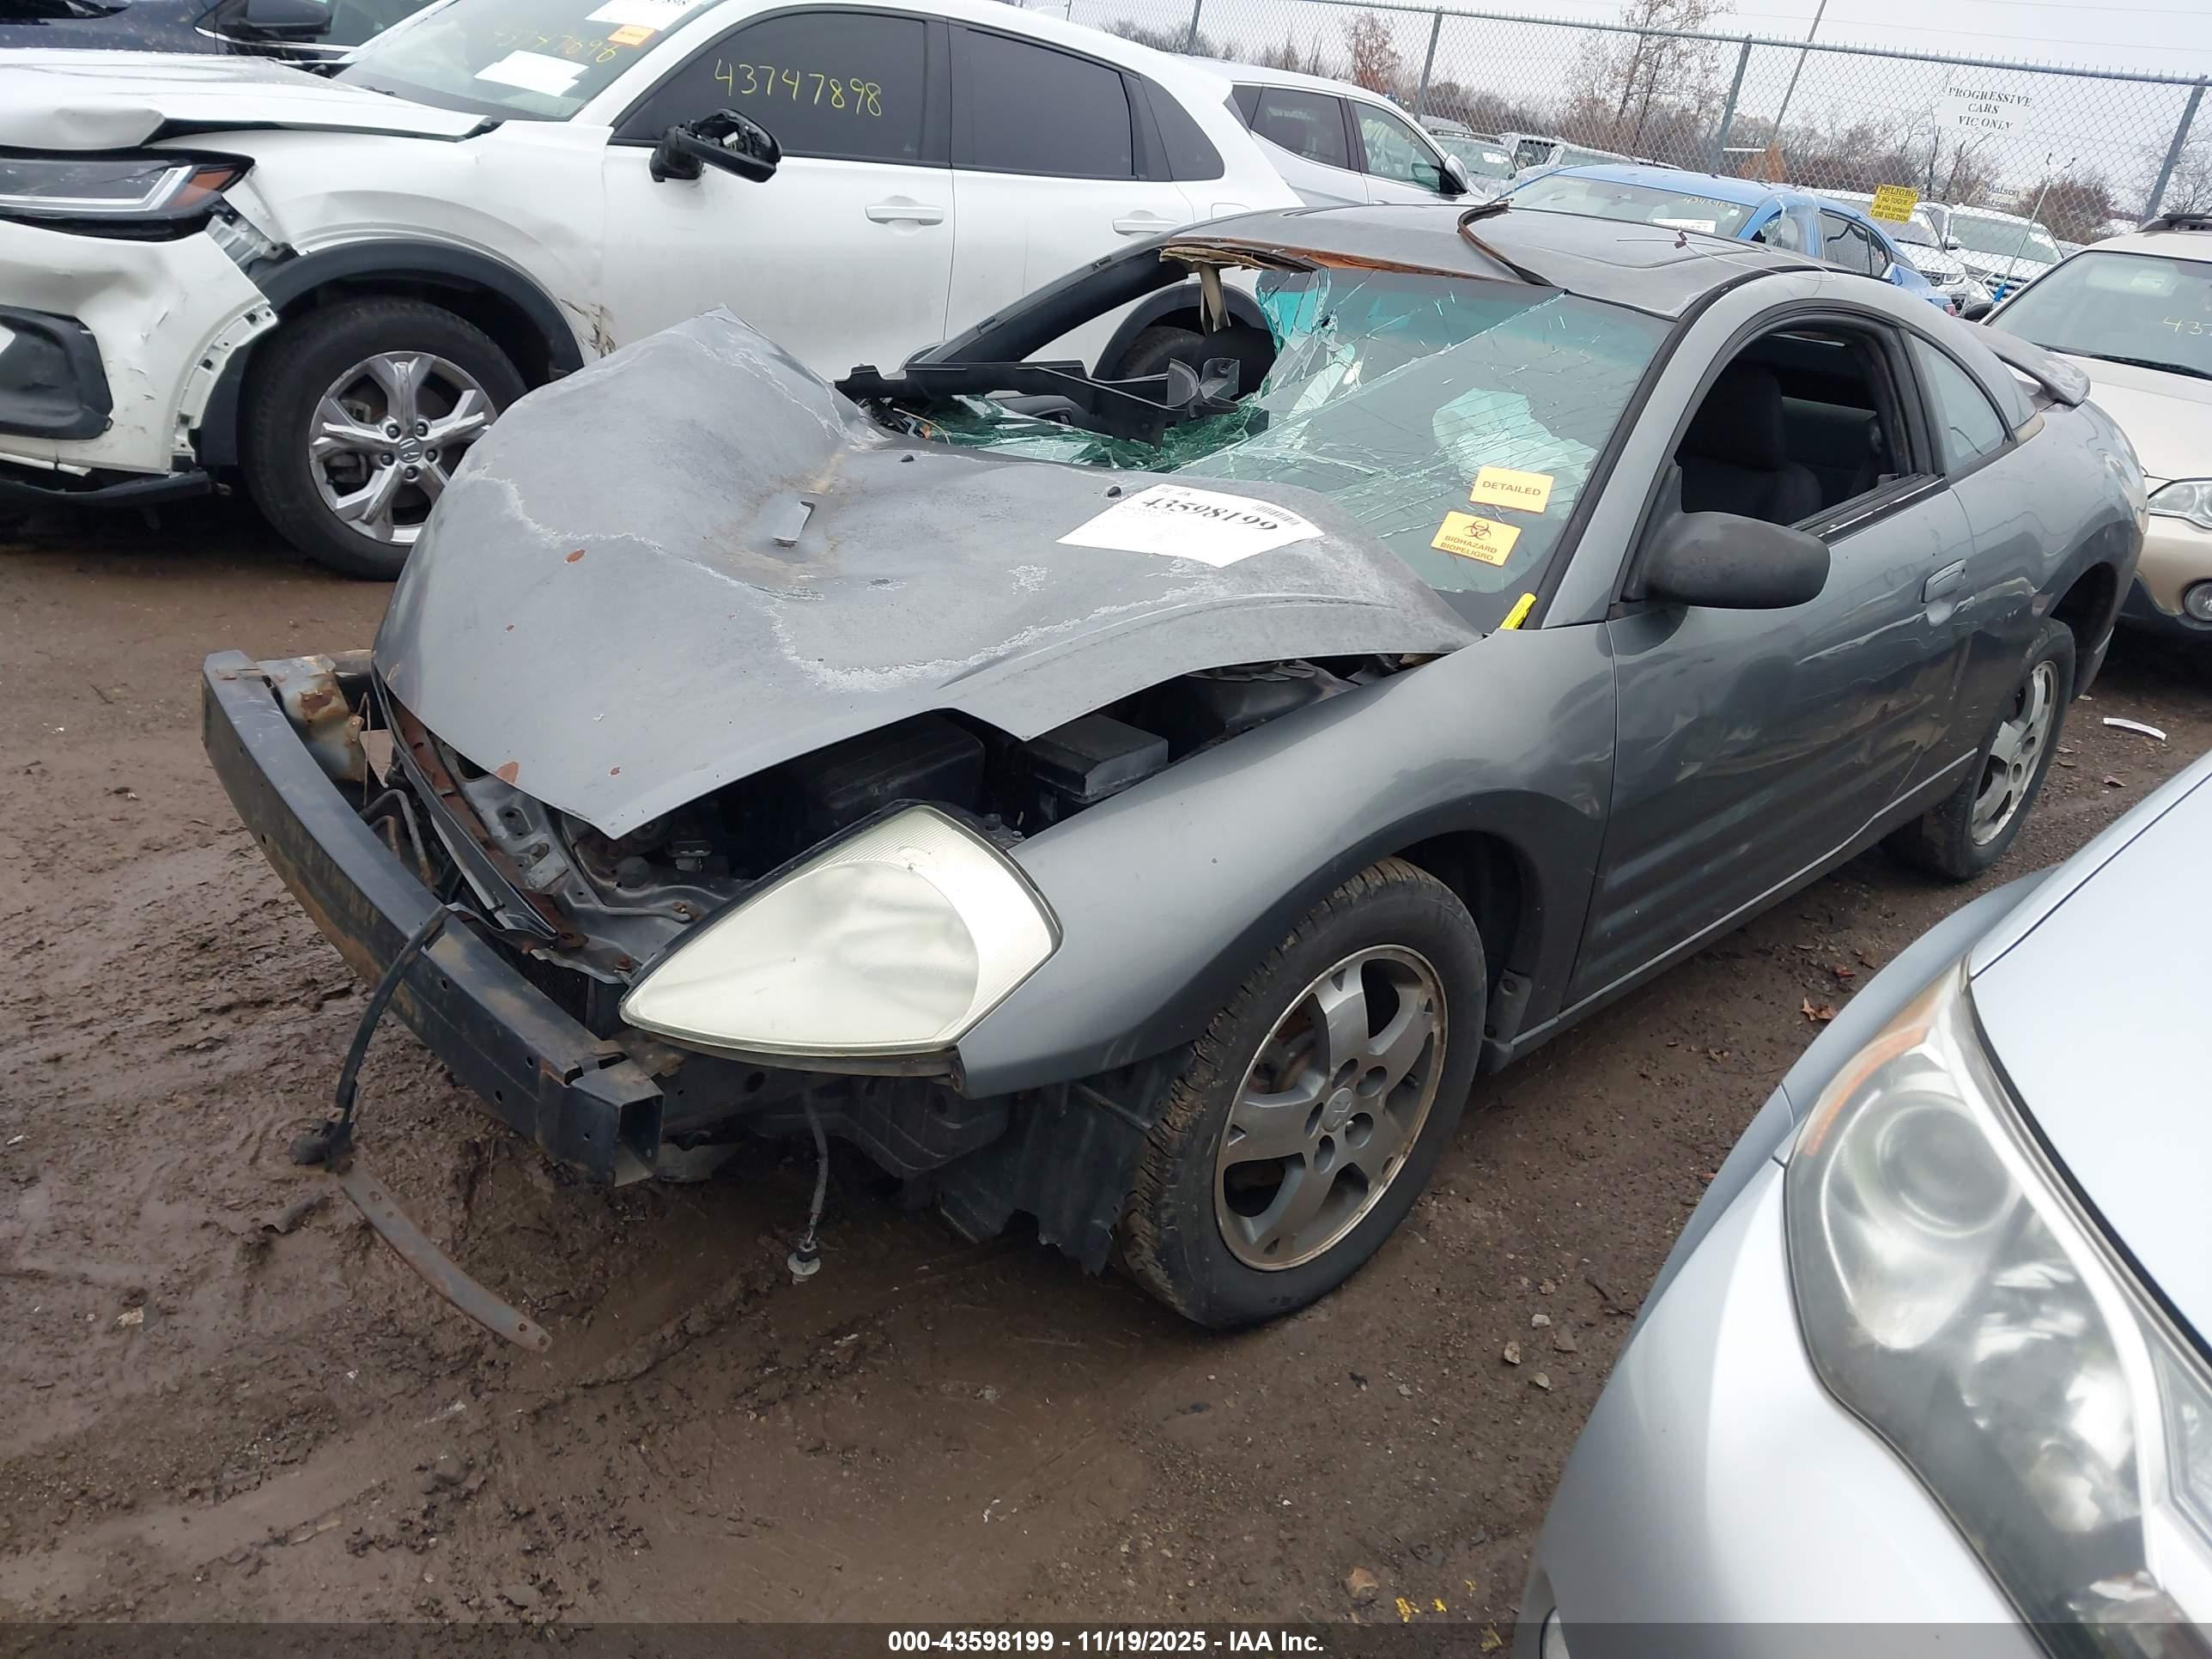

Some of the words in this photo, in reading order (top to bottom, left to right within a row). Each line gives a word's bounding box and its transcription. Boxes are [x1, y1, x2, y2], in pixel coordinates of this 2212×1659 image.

[714, 58, 882, 117] 43747898
[1948, 87, 2033, 107] PROGRESSIVE
[1967, 102, 2000, 114] CARS
[1958, 115, 1979, 127] VIC
[1981, 118, 2014, 131] ONLY
[1880, 185, 1917, 198] PELIGRO
[1482, 480, 1541, 496] DETAILED
[1140, 496, 1279, 531] 43598199
[1439, 542, 1494, 561] BIOPELIGRO
[1443, 534, 1498, 555] BIOHAZARD
